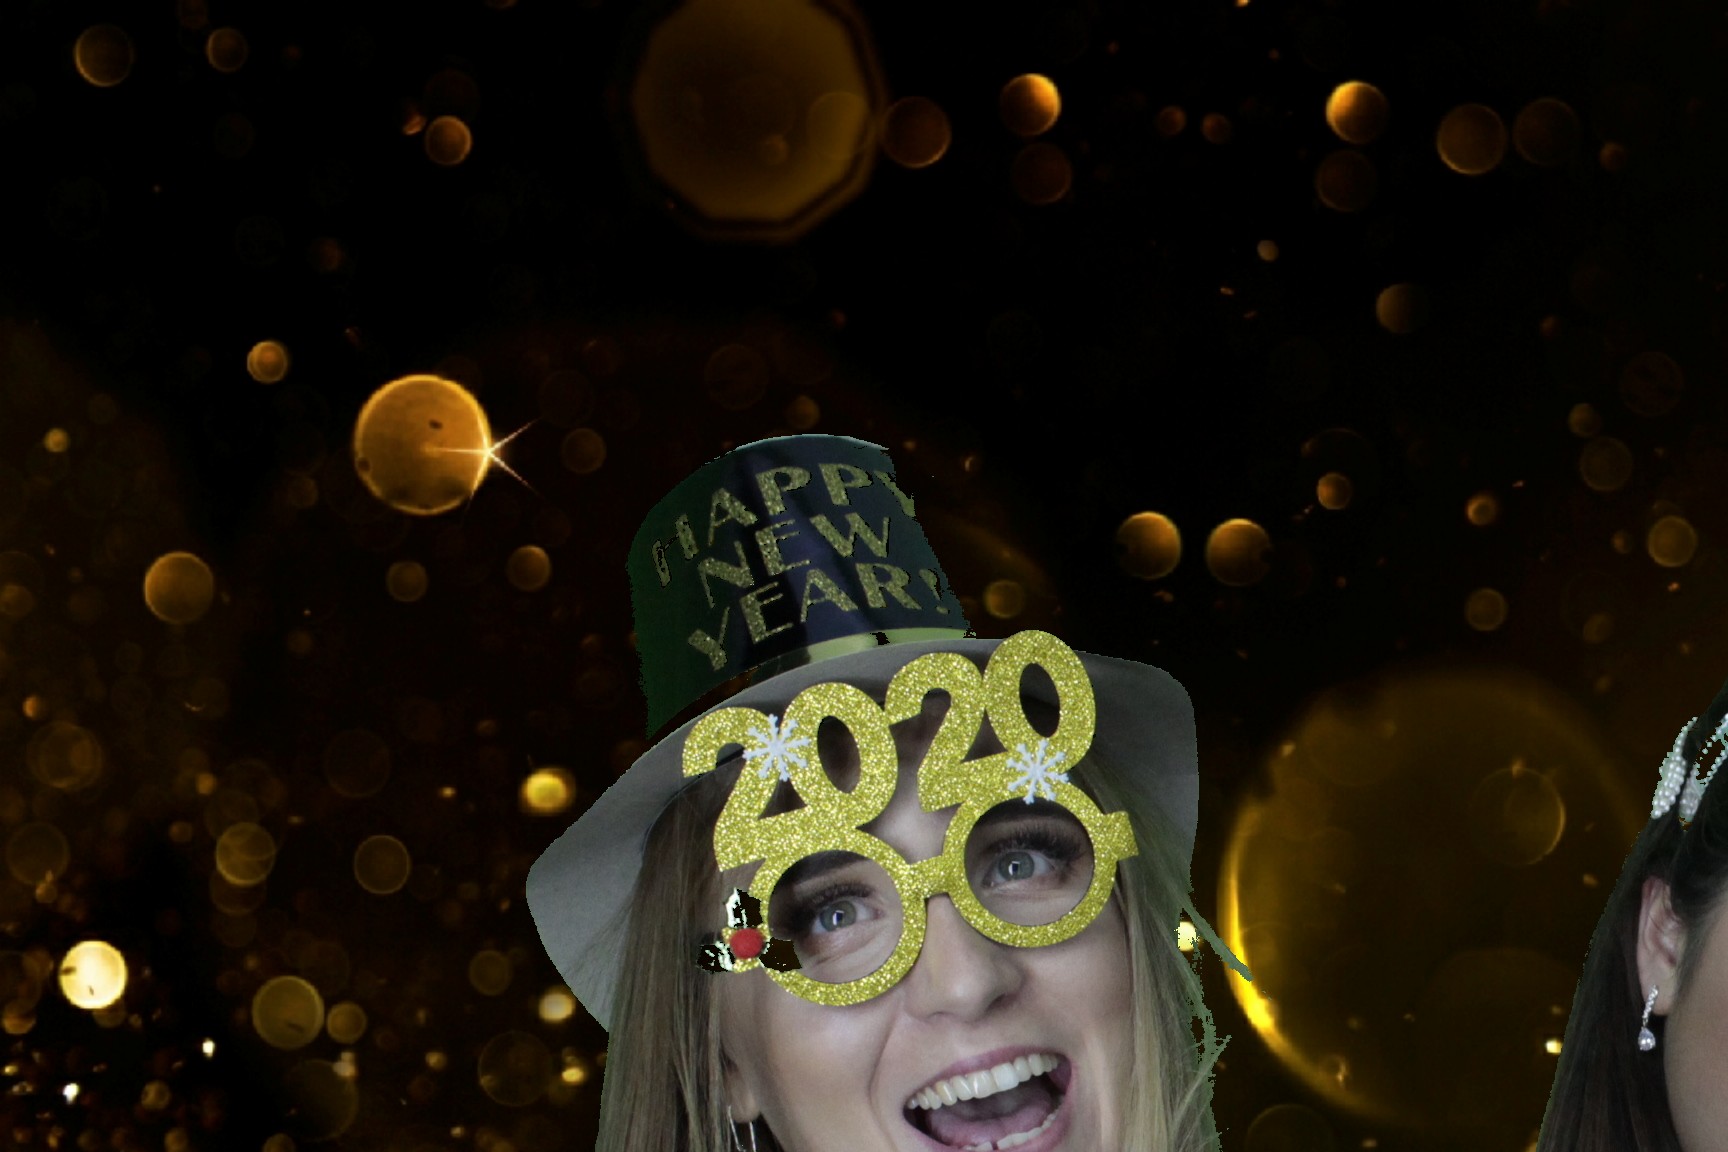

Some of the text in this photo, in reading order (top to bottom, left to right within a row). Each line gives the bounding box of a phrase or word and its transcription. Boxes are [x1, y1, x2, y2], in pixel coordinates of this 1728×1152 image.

[698, 512, 892, 609] NEW
[688, 563, 950, 671] YEAR!
[682, 630, 1096, 873] 2020
